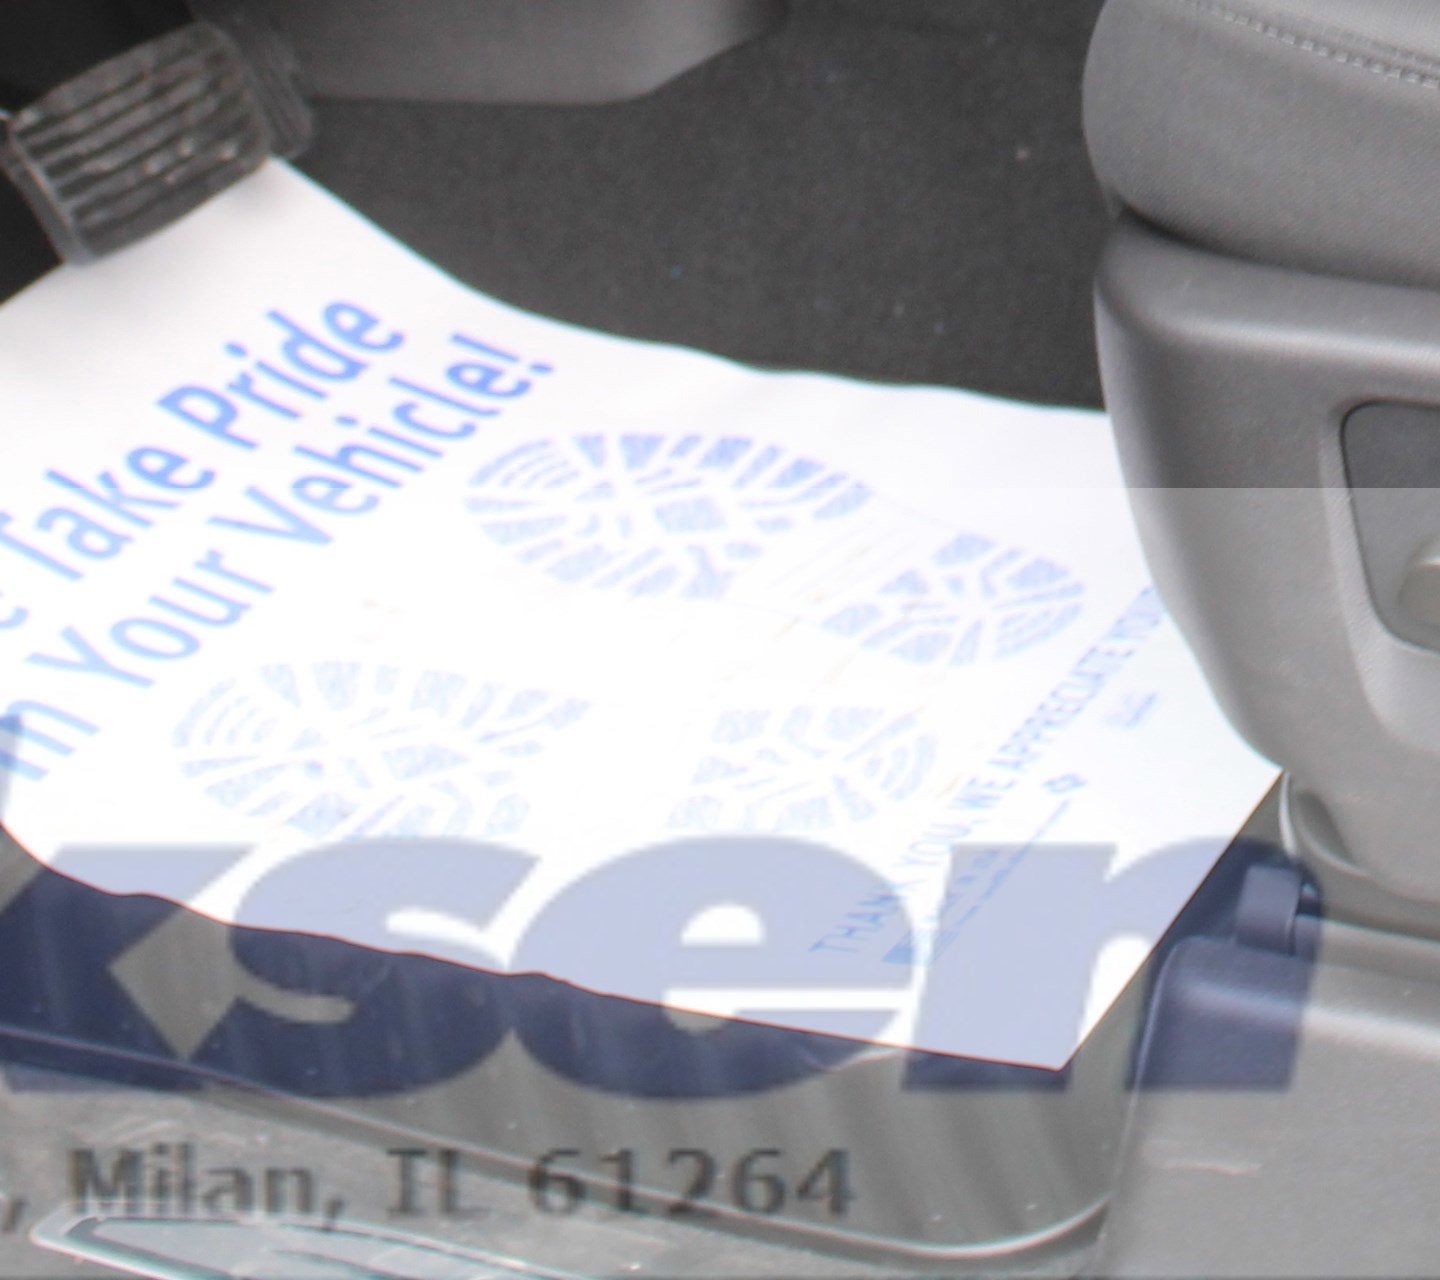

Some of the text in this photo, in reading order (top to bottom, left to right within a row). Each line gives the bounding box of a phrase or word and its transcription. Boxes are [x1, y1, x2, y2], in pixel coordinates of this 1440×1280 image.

[154, 297, 407, 451] Pride
[23, 547, 276, 689] Your
[206, 332, 556, 547] Vehicle!
[948, 776, 1015, 811] WE
[986, 645, 1135, 772] APPRECIATE
